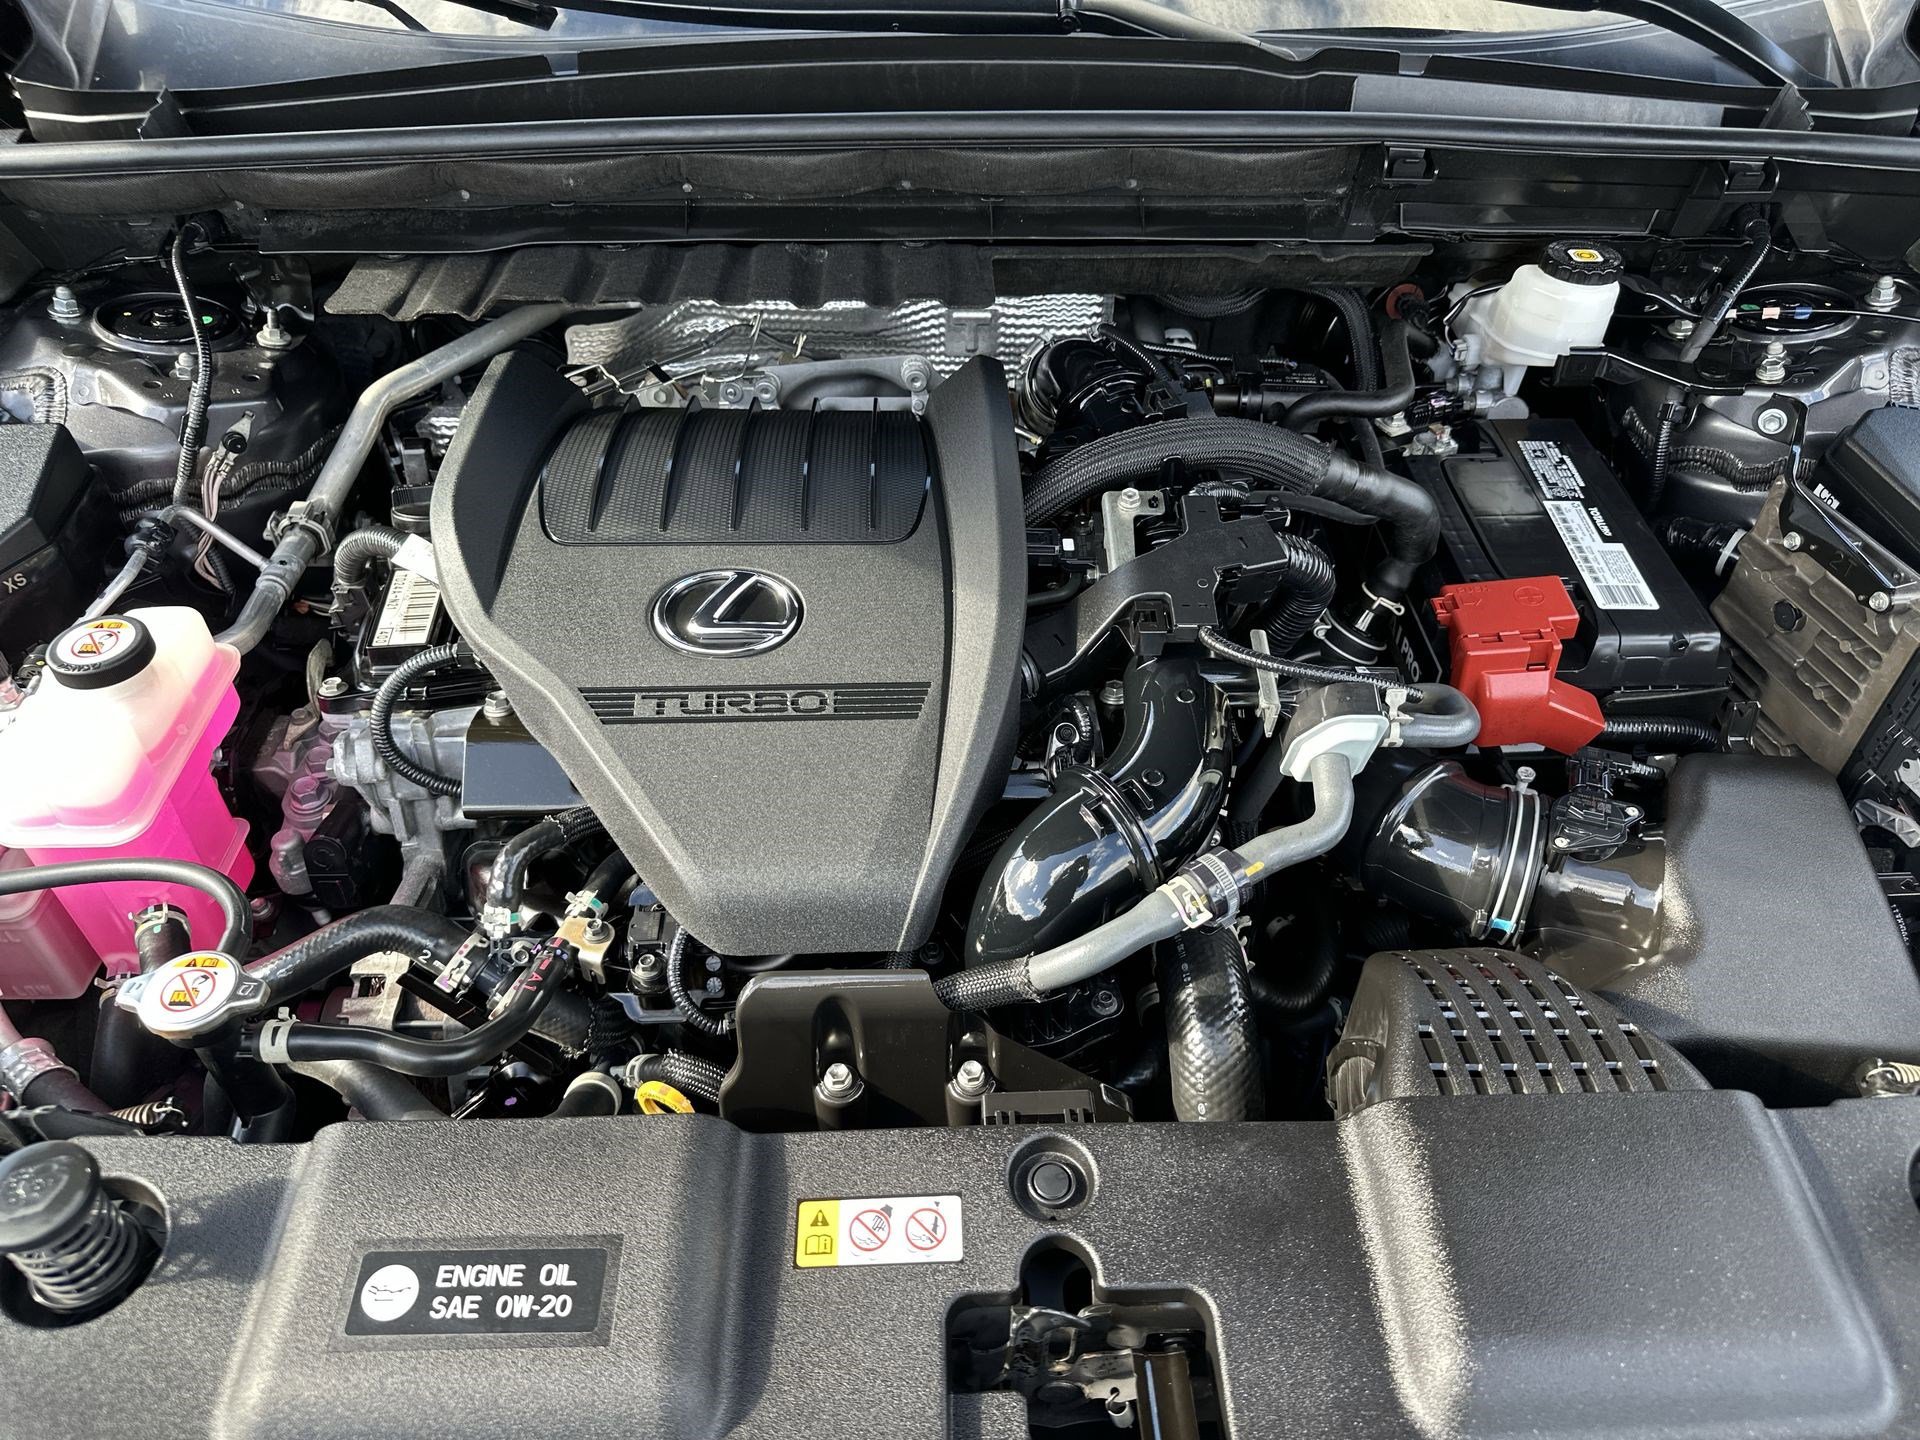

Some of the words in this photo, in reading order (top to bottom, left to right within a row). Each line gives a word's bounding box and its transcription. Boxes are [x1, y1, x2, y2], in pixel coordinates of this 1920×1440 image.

[3, 573, 27, 594] XS
[640, 691, 830, 715] TURBO
[435, 1263, 527, 1288] ENGINE
[539, 1263, 578, 1287] OIL
[429, 1295, 483, 1319] SAE
[495, 1294, 573, 1319] 0W-20
